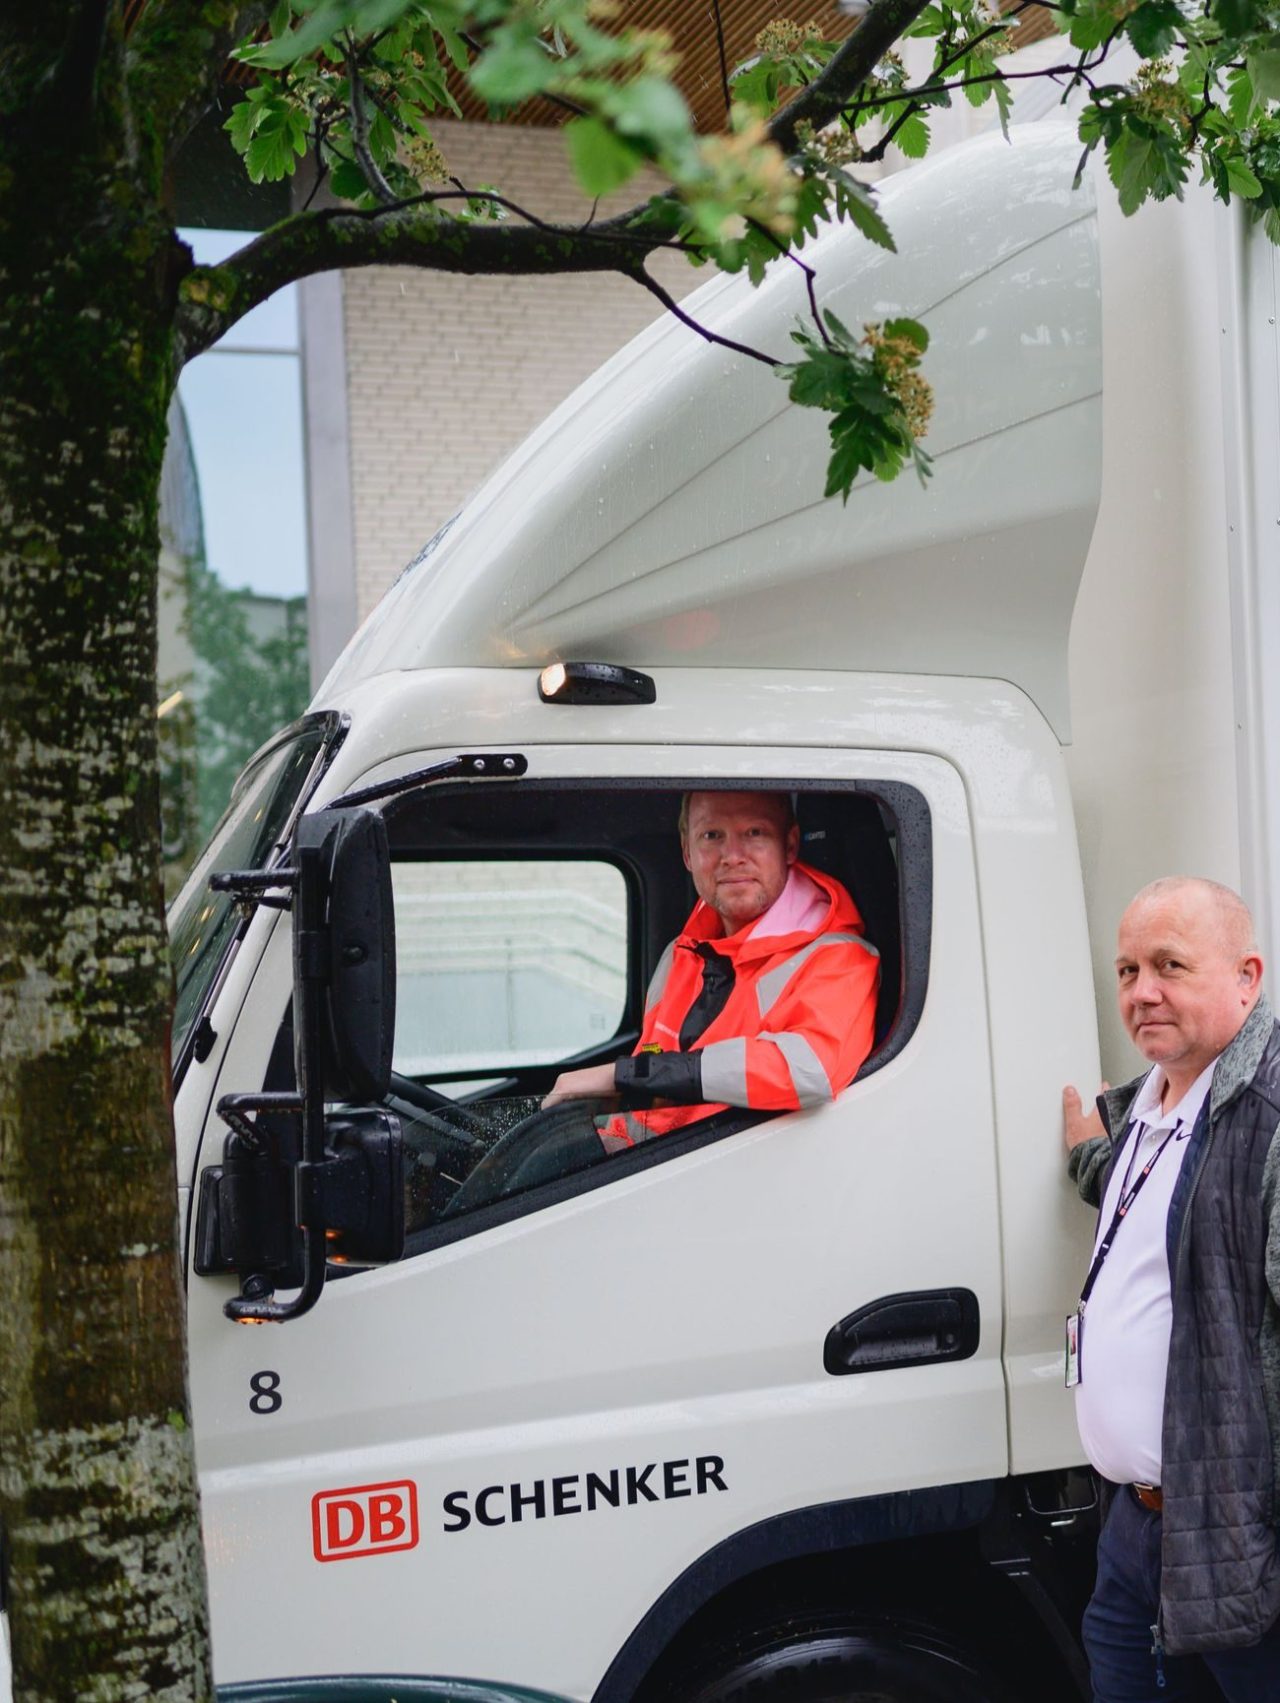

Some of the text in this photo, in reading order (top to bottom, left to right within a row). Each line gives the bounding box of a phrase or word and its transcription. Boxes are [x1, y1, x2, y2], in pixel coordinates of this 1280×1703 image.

[248, 1370, 283, 1415] 8
[325, 1455, 729, 1550] DB SCHENKER
